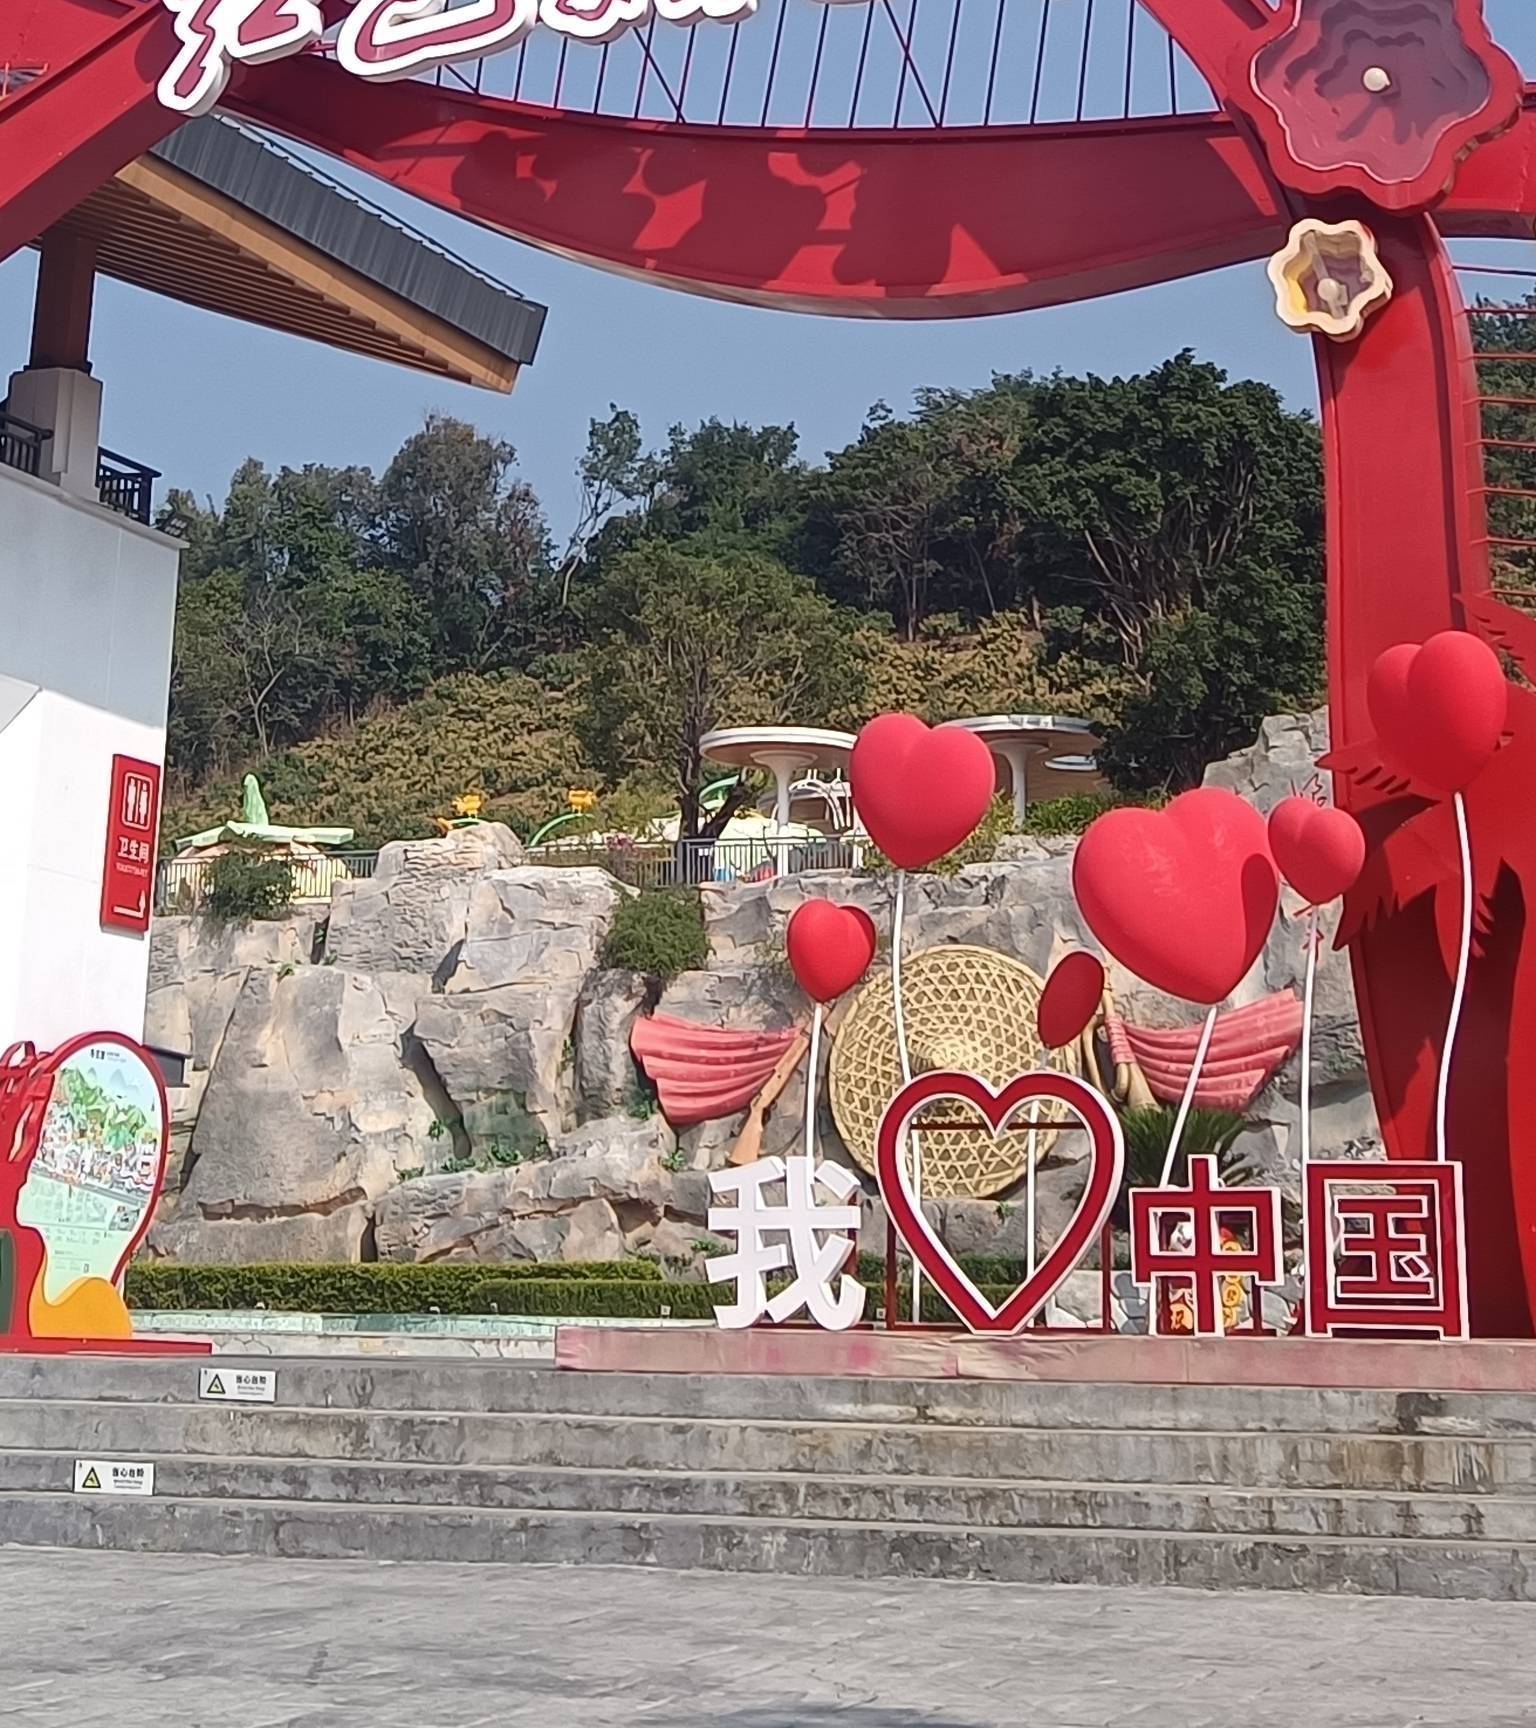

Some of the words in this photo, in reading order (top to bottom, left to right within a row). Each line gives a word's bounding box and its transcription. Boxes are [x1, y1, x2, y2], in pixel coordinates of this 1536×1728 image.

[117, 836, 150, 864] 卫生间
[703, 1156, 866, 1331] 我
[1128, 1154, 1471, 1341] 中国
